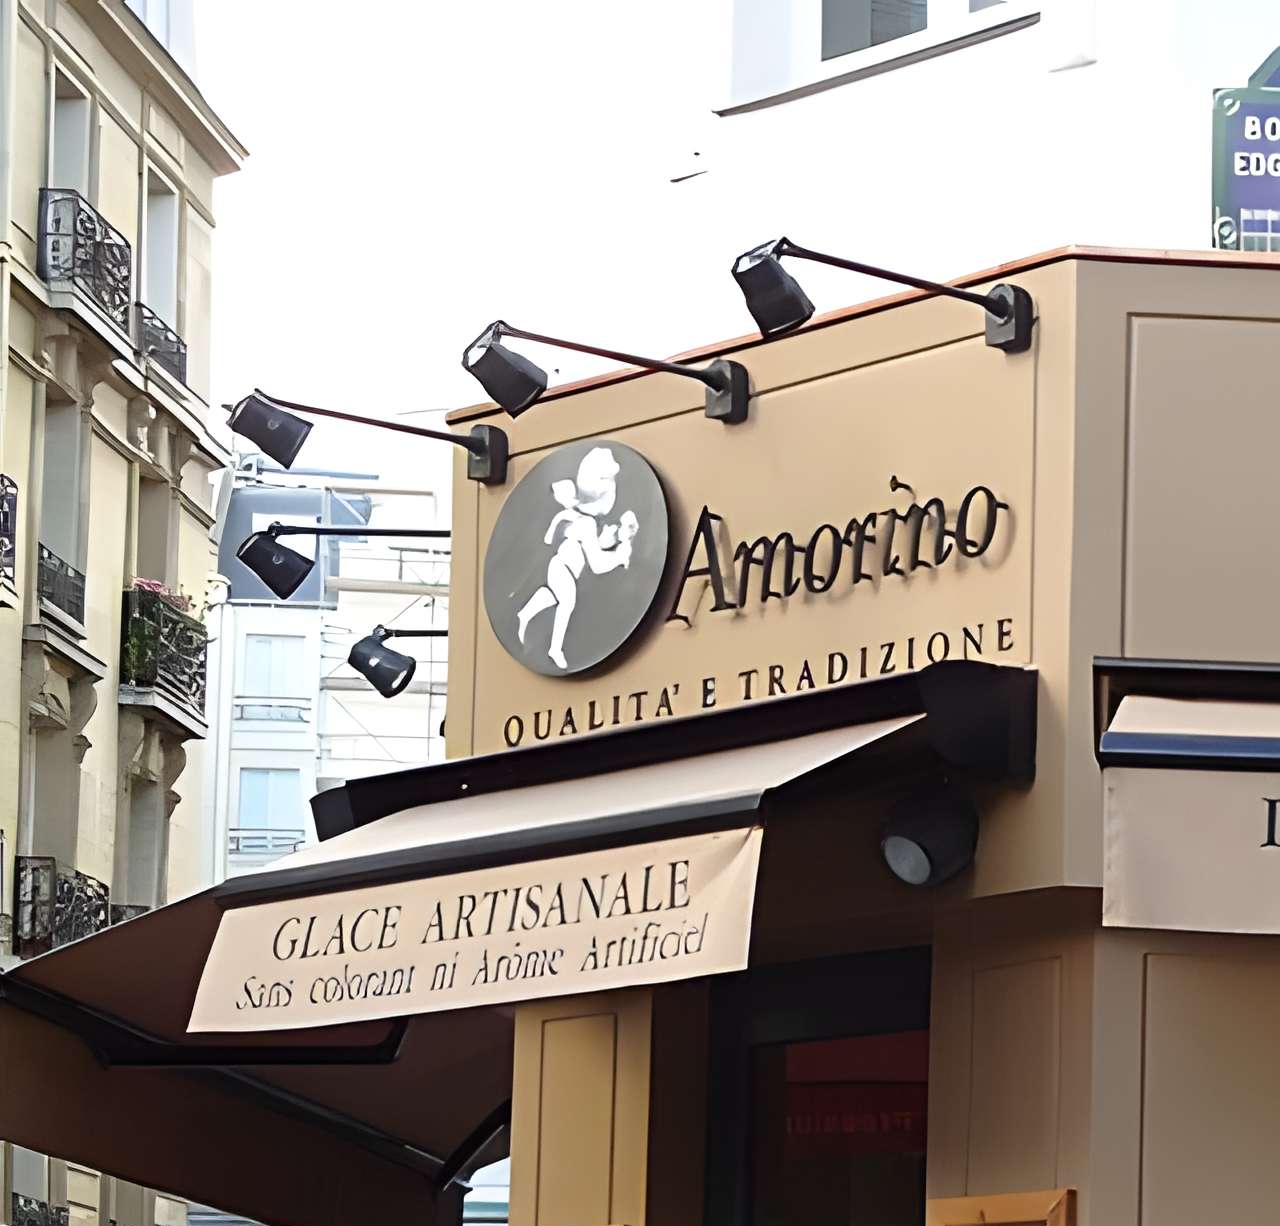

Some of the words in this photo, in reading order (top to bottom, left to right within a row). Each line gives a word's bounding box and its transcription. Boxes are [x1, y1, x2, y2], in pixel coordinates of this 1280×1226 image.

[666, 474, 1009, 628] Amorino
[701, 677, 717, 708] E
[738, 618, 1016, 701] TRADIZIONE
[272, 904, 402, 962] GLACE
[421, 859, 692, 946] ARTISANALE
[236, 976, 295, 1010] Sans
[308, 963, 415, 1006] colorant
[430, 953, 458, 990] ni
[580, 913, 708, 973] Artificiel
